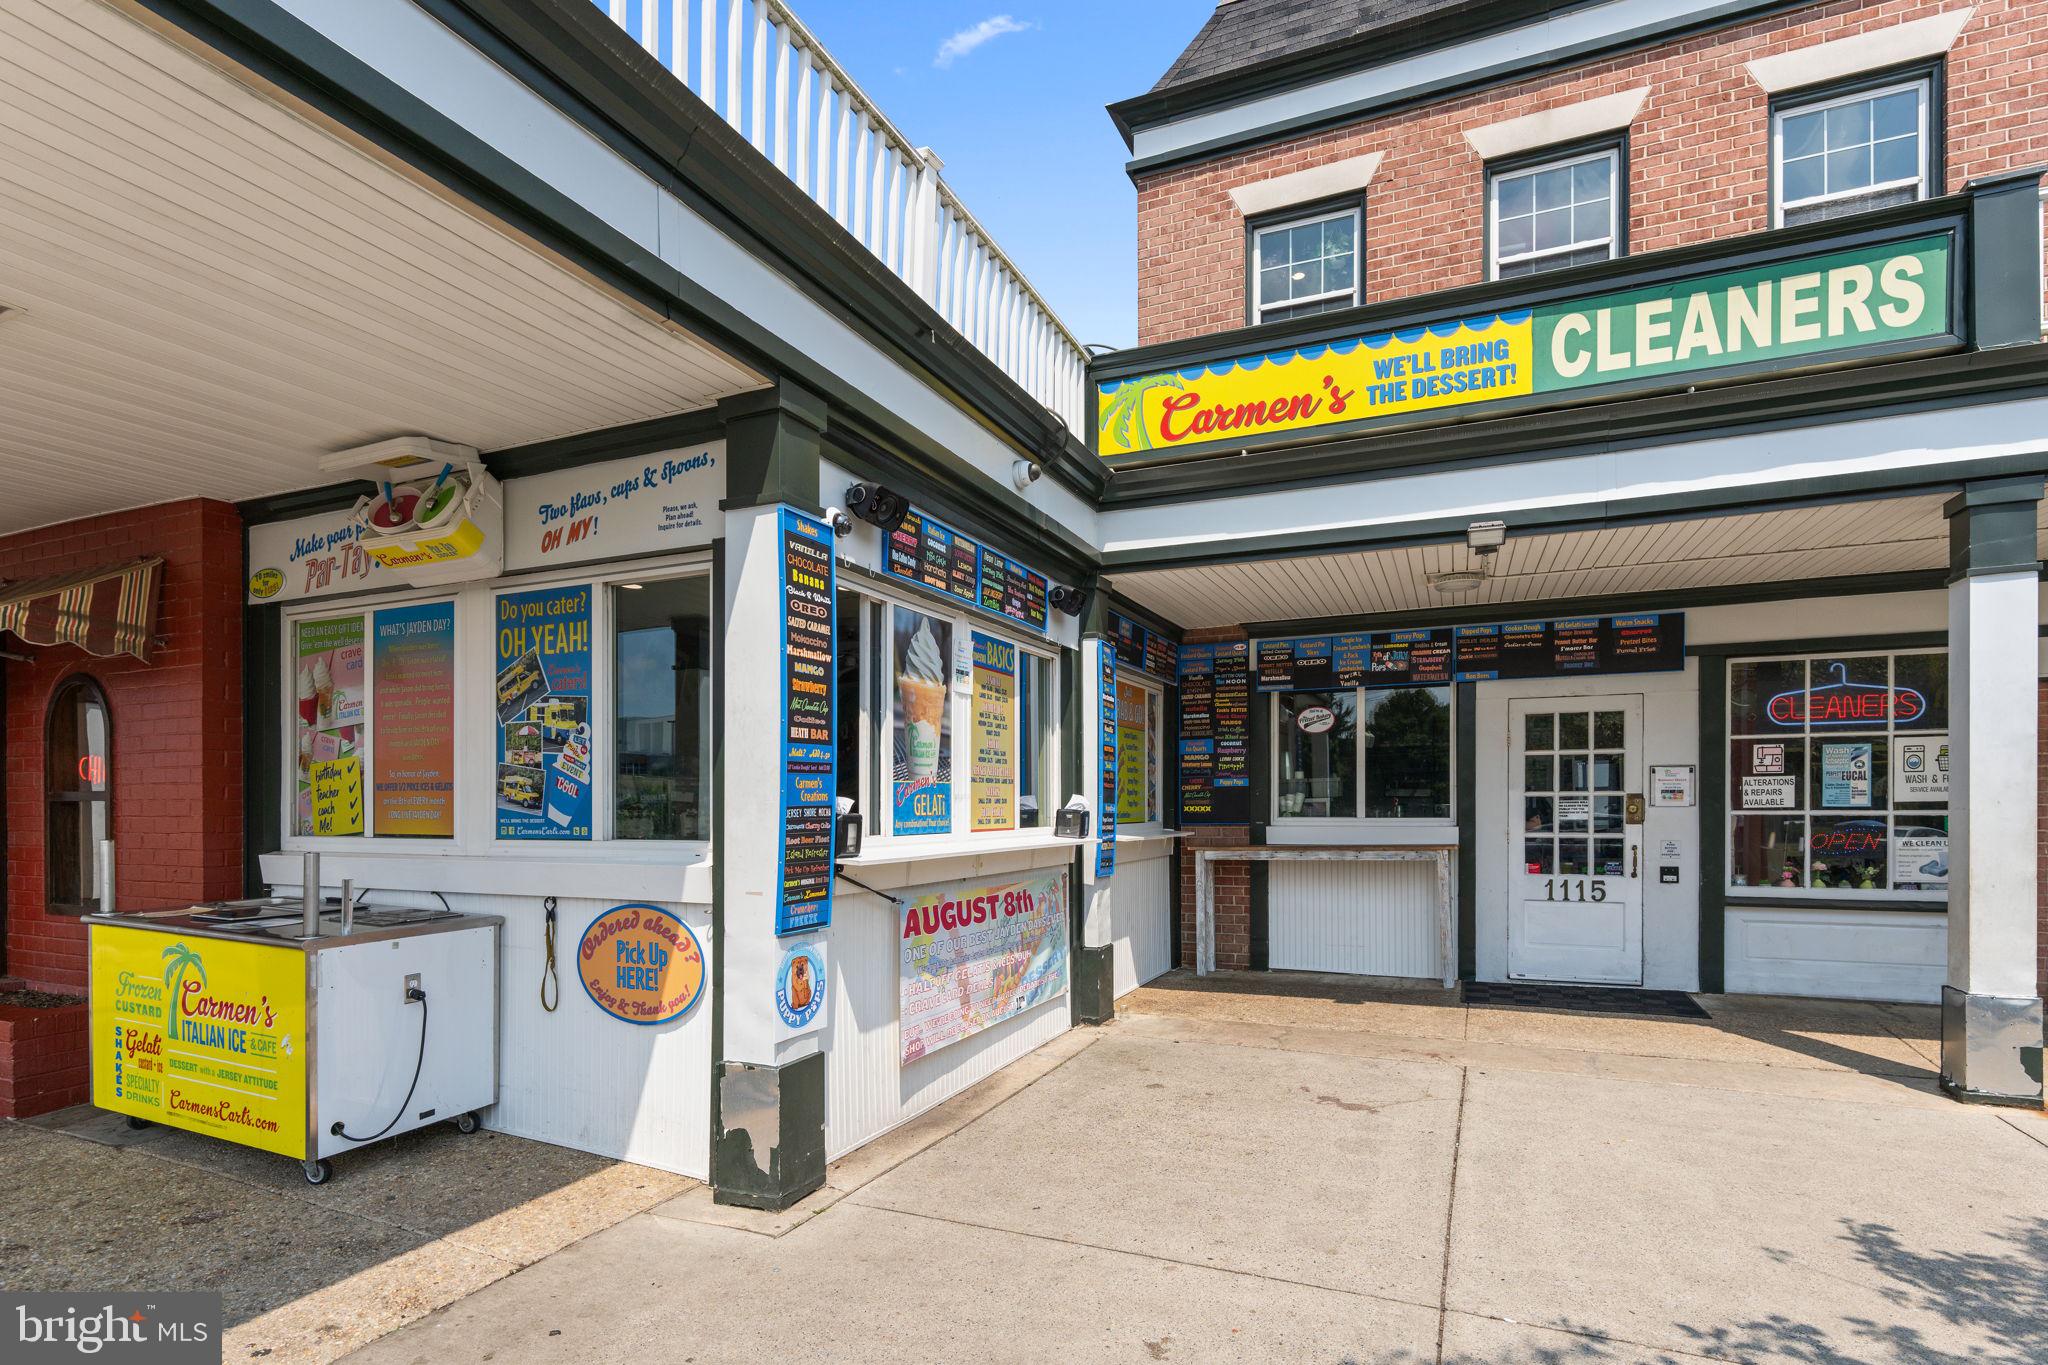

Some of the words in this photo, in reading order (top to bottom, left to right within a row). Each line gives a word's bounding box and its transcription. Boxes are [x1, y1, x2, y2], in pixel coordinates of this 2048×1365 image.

[1551, 255, 1925, 378] CLEANERS
[1373, 354, 1433, 381] WE'LL
[1441, 338, 1509, 370] BRING
[1366, 380, 1408, 406] THE
[1412, 363, 1517, 401] DESSERT!
[1159, 374, 1355, 443] Carmen's
[538, 504, 568, 526] Two
[569, 491, 608, 518] flavs,
[610, 477, 640, 499] cups
[643, 467, 658, 488] &
[541, 526, 564, 553] OH
[566, 515, 599, 545] MY!
[796, 519, 818, 537] Shakes
[290, 533, 324, 562] Make
[326, 527, 352, 551] your
[787, 553, 829, 577] CHOCOLATE
[792, 568, 825, 590] Banana
[501, 600, 518, 621] Do
[521, 602, 544, 623] you
[546, 592, 586, 616] cater?
[790, 599, 827, 618] OREO
[379, 622, 406, 637] WHAT'S
[406, 620, 432, 636] JAYDEN
[433, 618, 451, 632] DAY?
[787, 615, 807, 629] SALTED
[807, 621, 831, 635] CARAMEL
[500, 627, 526, 659] OH
[531, 619, 588, 656] YEAH!
[341, 647, 362, 660] crave
[346, 659, 363, 670] card
[787, 644, 832, 663] Marshmallow
[986, 641, 1014, 672] BASICS
[1297, 658, 1327, 666] OREO
[794, 662, 825, 676] MANGO
[1771, 692, 1919, 720] CLEANERS
[790, 727, 809, 739] HEATH
[810, 728, 829, 740] BAR
[1217, 747, 1246, 755] Raspberry
[795, 776, 823, 789] Carmen's
[1744, 778, 1795, 787] ALTERATIONS
[1841, 770, 1868, 781] EUCAL
[1905, 775, 1928, 784] WASH
[1932, 775, 1938, 783] &
[316, 785, 340, 801] teacher
[800, 790, 828, 802] Creations
[896, 770, 937, 808] Carmen's
[1750, 788, 1783, 796] REPAIRS
[317, 804, 336, 816] coach
[786, 808, 802, 818] JERSEY
[803, 808, 817, 817] SHORE
[1744, 798, 1784, 806] AVAILABLE
[319, 819, 333, 833] Me!
[786, 837, 800, 845] Root
[1810, 831, 1884, 850] OPEN
[1545, 879, 1606, 902] 1115
[903, 894, 999, 939] AUGUST
[1004, 888, 1034, 917] 8th
[582, 910, 640, 961] Ordered
[643, 916, 700, 963] ahead?
[904, 945, 926, 964] ONE
[928, 941, 944, 957] OF
[945, 936, 968, 953] OUR
[968, 930, 993, 948] BEST
[993, 922, 1027, 940] JAYDEN
[616, 939, 646, 965] Pick
[649, 942, 668, 972] Up
[115, 970, 162, 1001] Frozen
[616, 966, 659, 992] HERE!
[181, 980, 278, 1028] Carmen's
[590, 979, 618, 1009] Enjoy
[617, 998, 630, 1014] &
[632, 1001, 668, 1016] Thank
[777, 989, 801, 1025] PUPPY
[909, 995, 941, 1016] CRAVE
[941, 986, 964, 1003] CARD
[966, 977, 994, 995] DEALS
[115, 999, 162, 1018] CUSTARD
[126, 1029, 163, 1058] Gelati
[181, 1020, 225, 1050] ITALIAN
[228, 1027, 247, 1054] ICE
[250, 1037, 256, 1050] &
[904, 1039, 925, 1056] SHOP
[925, 1030, 946, 1048] WILL
[115, 1026, 123, 1097] SHAKES
[126, 1073, 160, 1094] SPECIALTY
[169, 1058, 198, 1072] DESSERT
[217, 1069, 243, 1082] JERSEY
[244, 1074, 278, 1090] ATTITUDE
[126, 1091, 160, 1107] DRINKS
[169, 1089, 280, 1133] CarmensCarts.com
